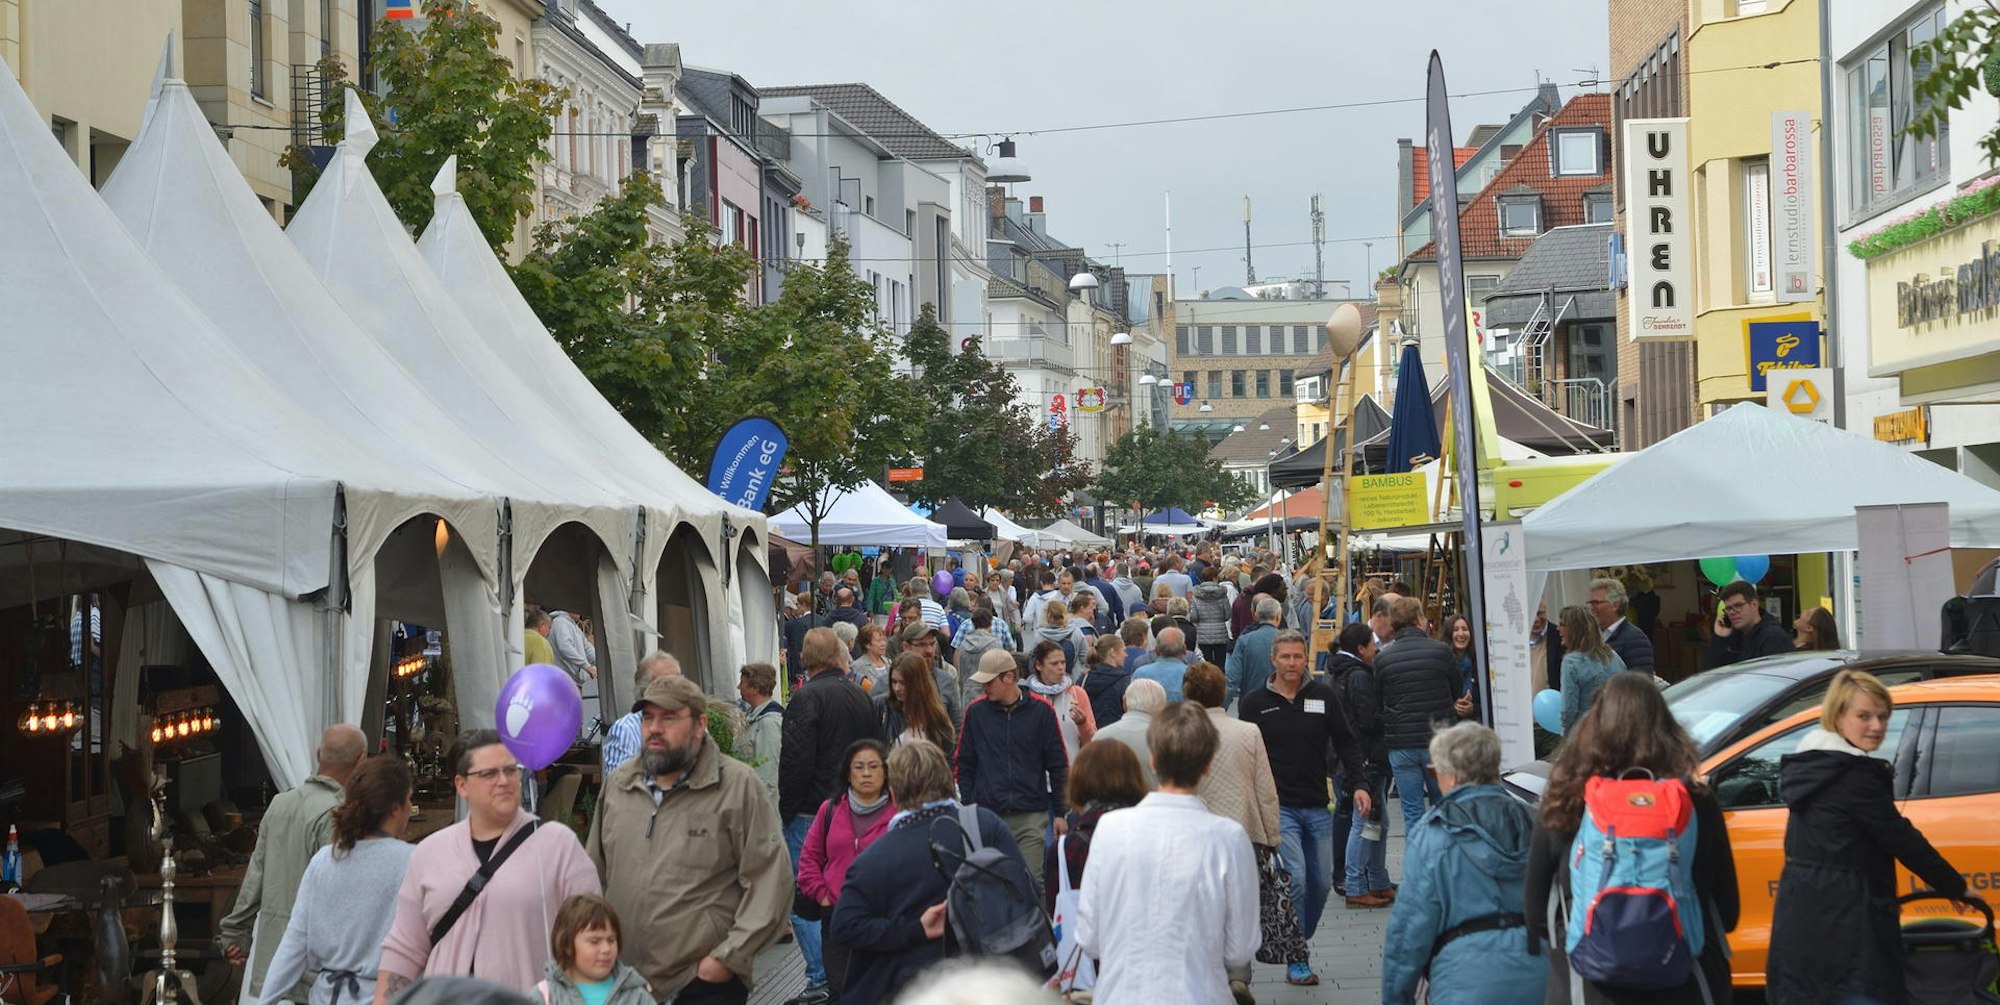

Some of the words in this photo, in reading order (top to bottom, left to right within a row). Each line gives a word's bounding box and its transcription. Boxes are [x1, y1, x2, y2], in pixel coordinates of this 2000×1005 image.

[1647, 131, 1676, 309] UHREN
[1784, 118, 1798, 266] lernstudiobarbarossa
[720, 435, 760, 489] Willkommen
[737, 468, 767, 510] Bank
[759, 440, 778, 465] eG
[1363, 476, 1412, 488] BAMBUS
